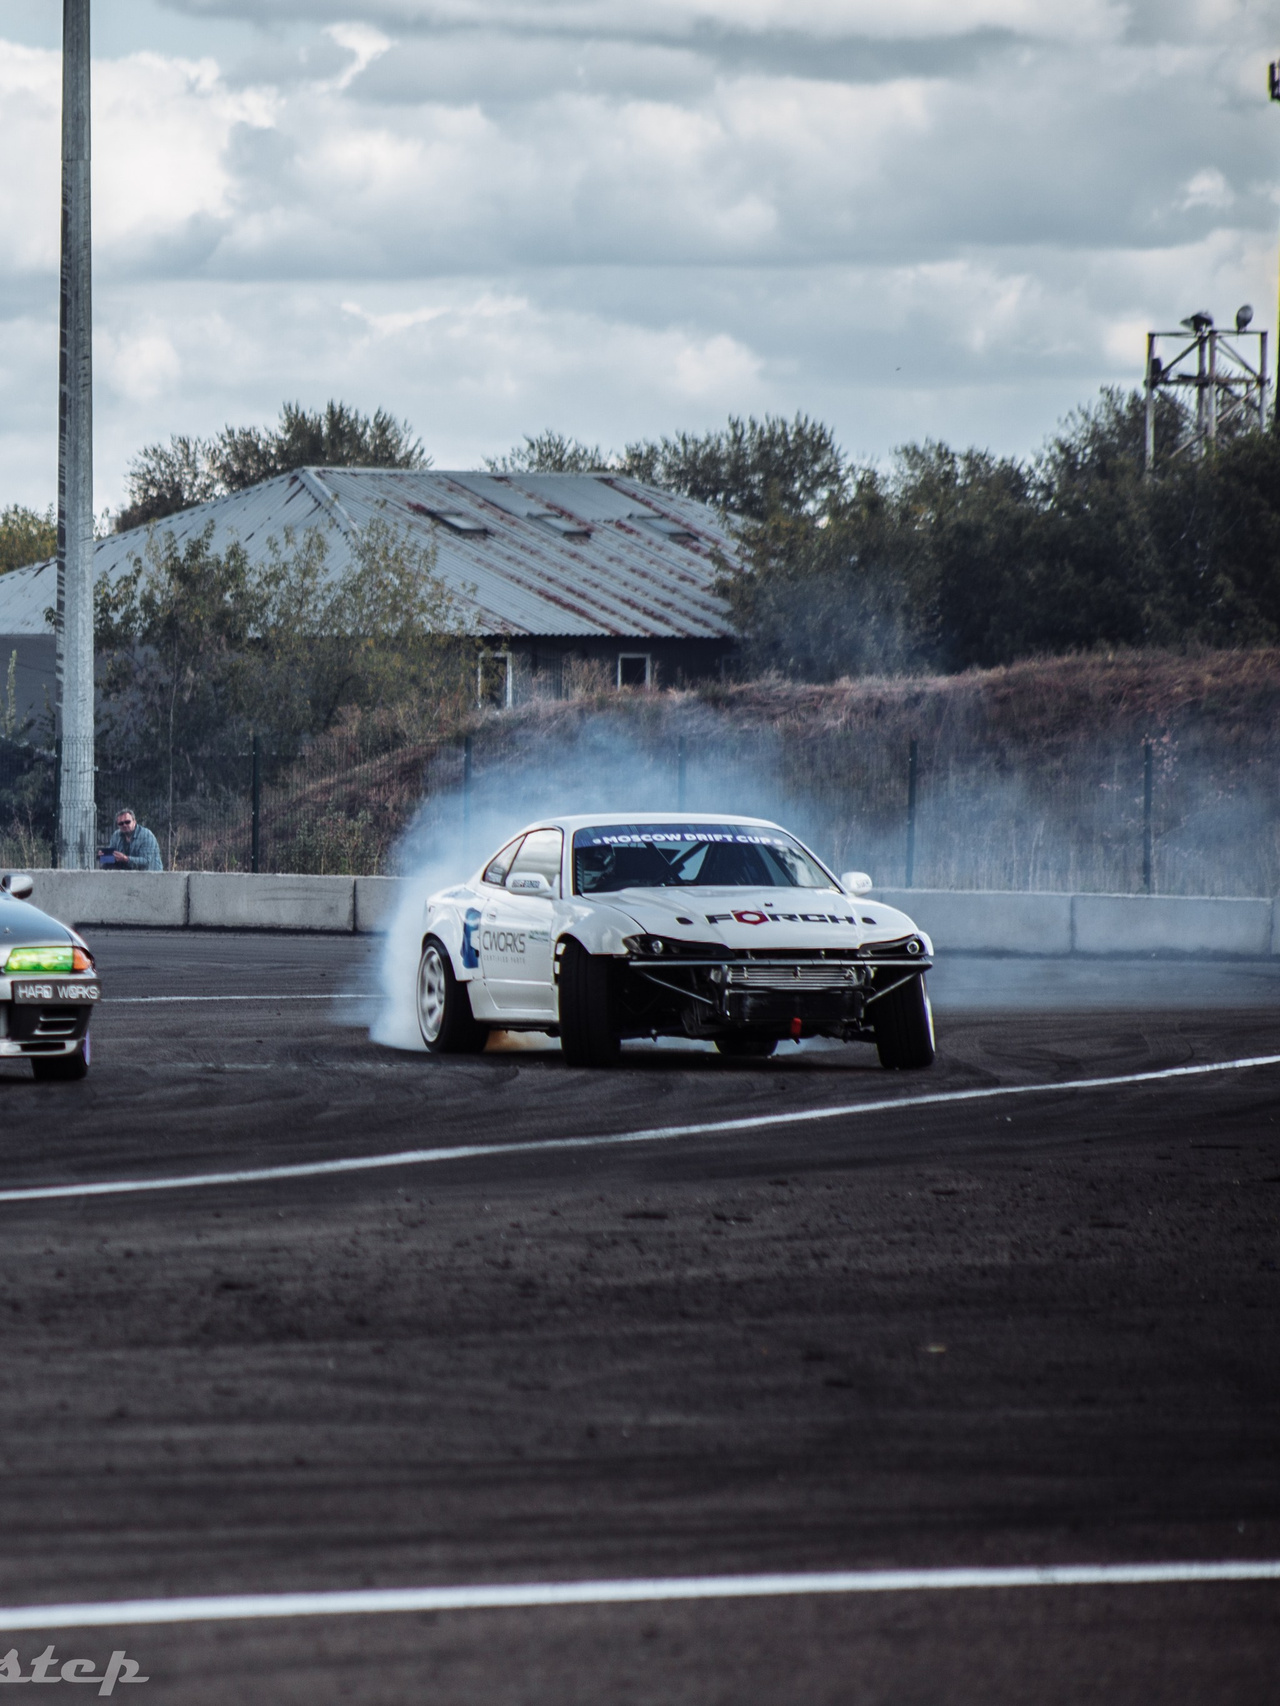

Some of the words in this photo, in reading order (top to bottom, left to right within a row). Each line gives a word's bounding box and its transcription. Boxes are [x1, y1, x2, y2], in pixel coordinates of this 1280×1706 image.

[602, 833, 682, 845] MOSCOW
[684, 833, 733, 843] DRIFT
[736, 835, 774, 845] CUP
[18, 984, 53, 999] HARD
[56, 984, 100, 1000] WORKS
